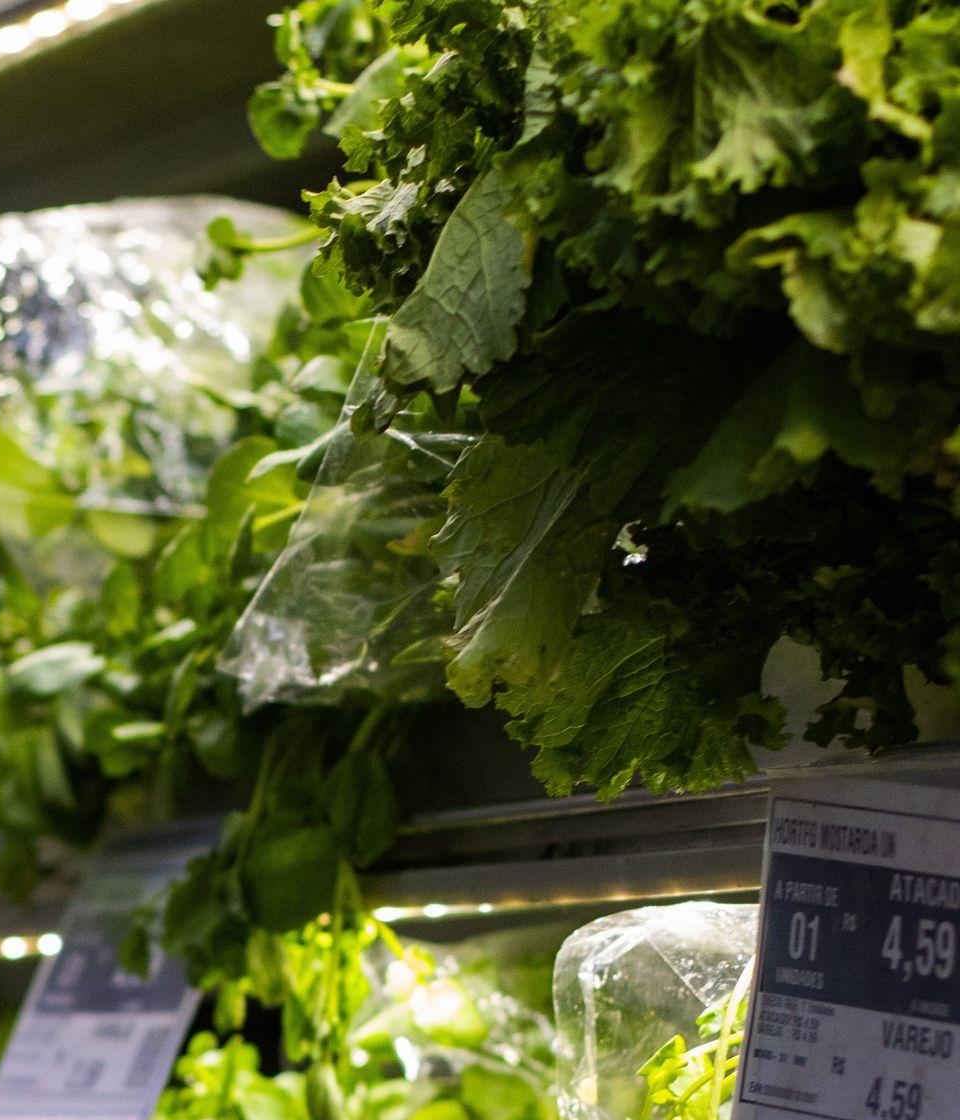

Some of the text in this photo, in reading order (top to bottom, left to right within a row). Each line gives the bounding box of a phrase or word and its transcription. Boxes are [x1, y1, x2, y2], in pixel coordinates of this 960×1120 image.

[774, 879, 839, 907] A PARTIR DE
[789, 911, 820, 962] 01
[881, 914, 956, 982] 4,59
[775, 966, 824, 990] UNIDADES
[881, 1019, 954, 1059] VAREJO
[832, 1055, 846, 1076] R$
